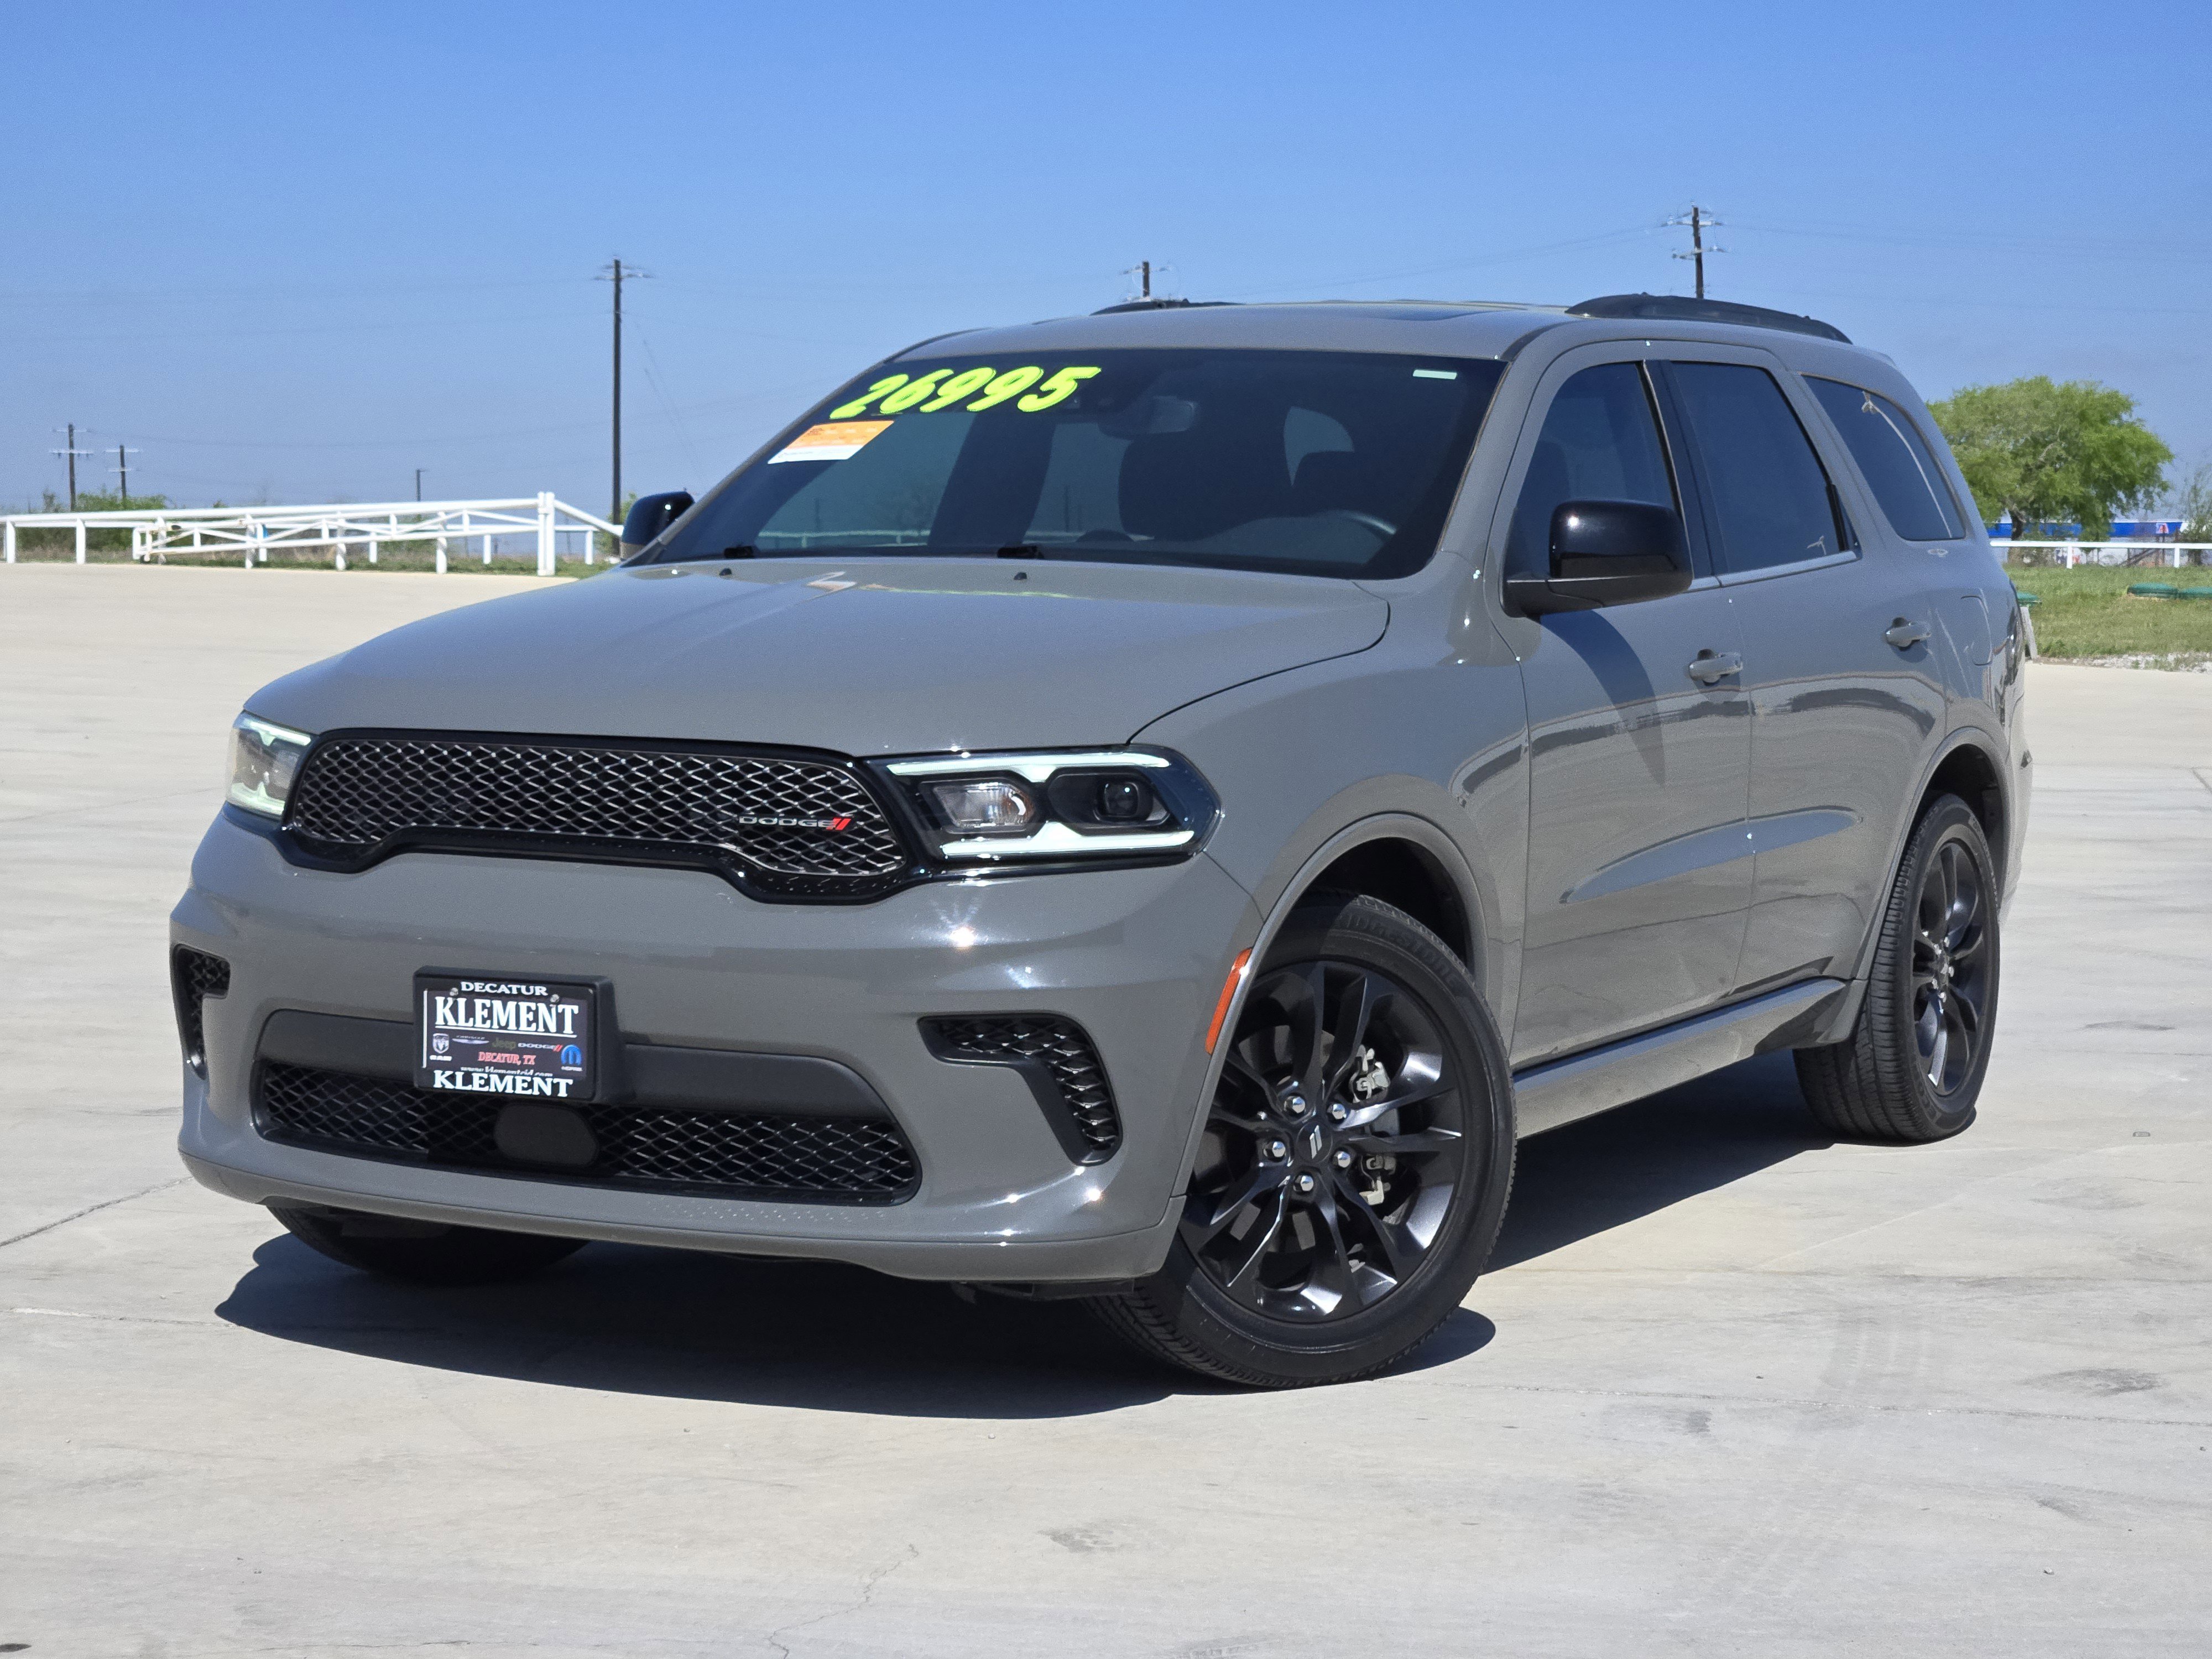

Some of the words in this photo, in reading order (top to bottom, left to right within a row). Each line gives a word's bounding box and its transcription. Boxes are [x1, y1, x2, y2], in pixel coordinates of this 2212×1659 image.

[830, 366, 1102, 419] 26995
[739, 816, 836, 829] DODGE
[461, 981, 548, 996] DECATUR
[435, 996, 579, 1034] KLEMENT
[478, 1051, 521, 1065] DECATUR,
[523, 1055, 536, 1065] TX
[433, 1070, 573, 1098] KLEMENT
